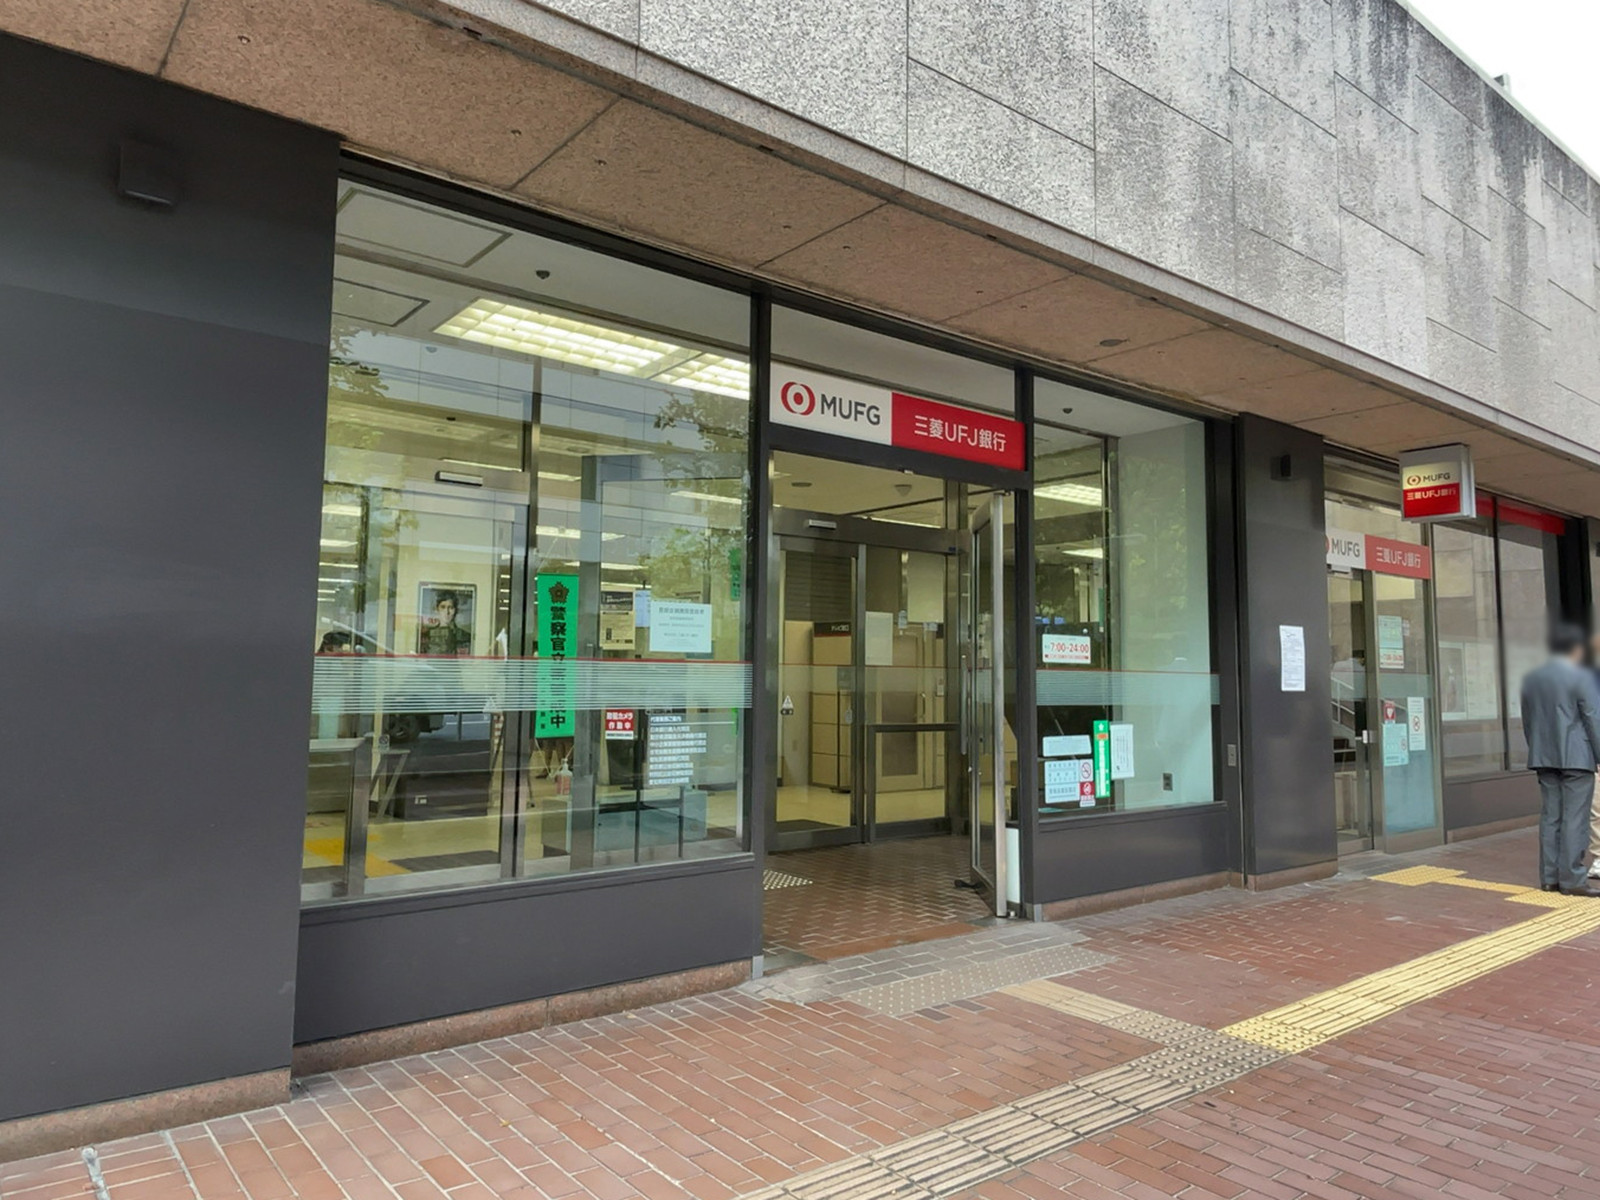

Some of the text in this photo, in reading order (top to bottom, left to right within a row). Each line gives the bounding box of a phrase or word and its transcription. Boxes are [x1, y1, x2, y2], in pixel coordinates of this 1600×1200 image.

[820, 393, 881, 426] MUFG
[914, 414, 1007, 453] 三菱UFJ銀行
[1423, 472, 1451, 483] MUFG
[1331, 538, 1360, 558] MUFG
